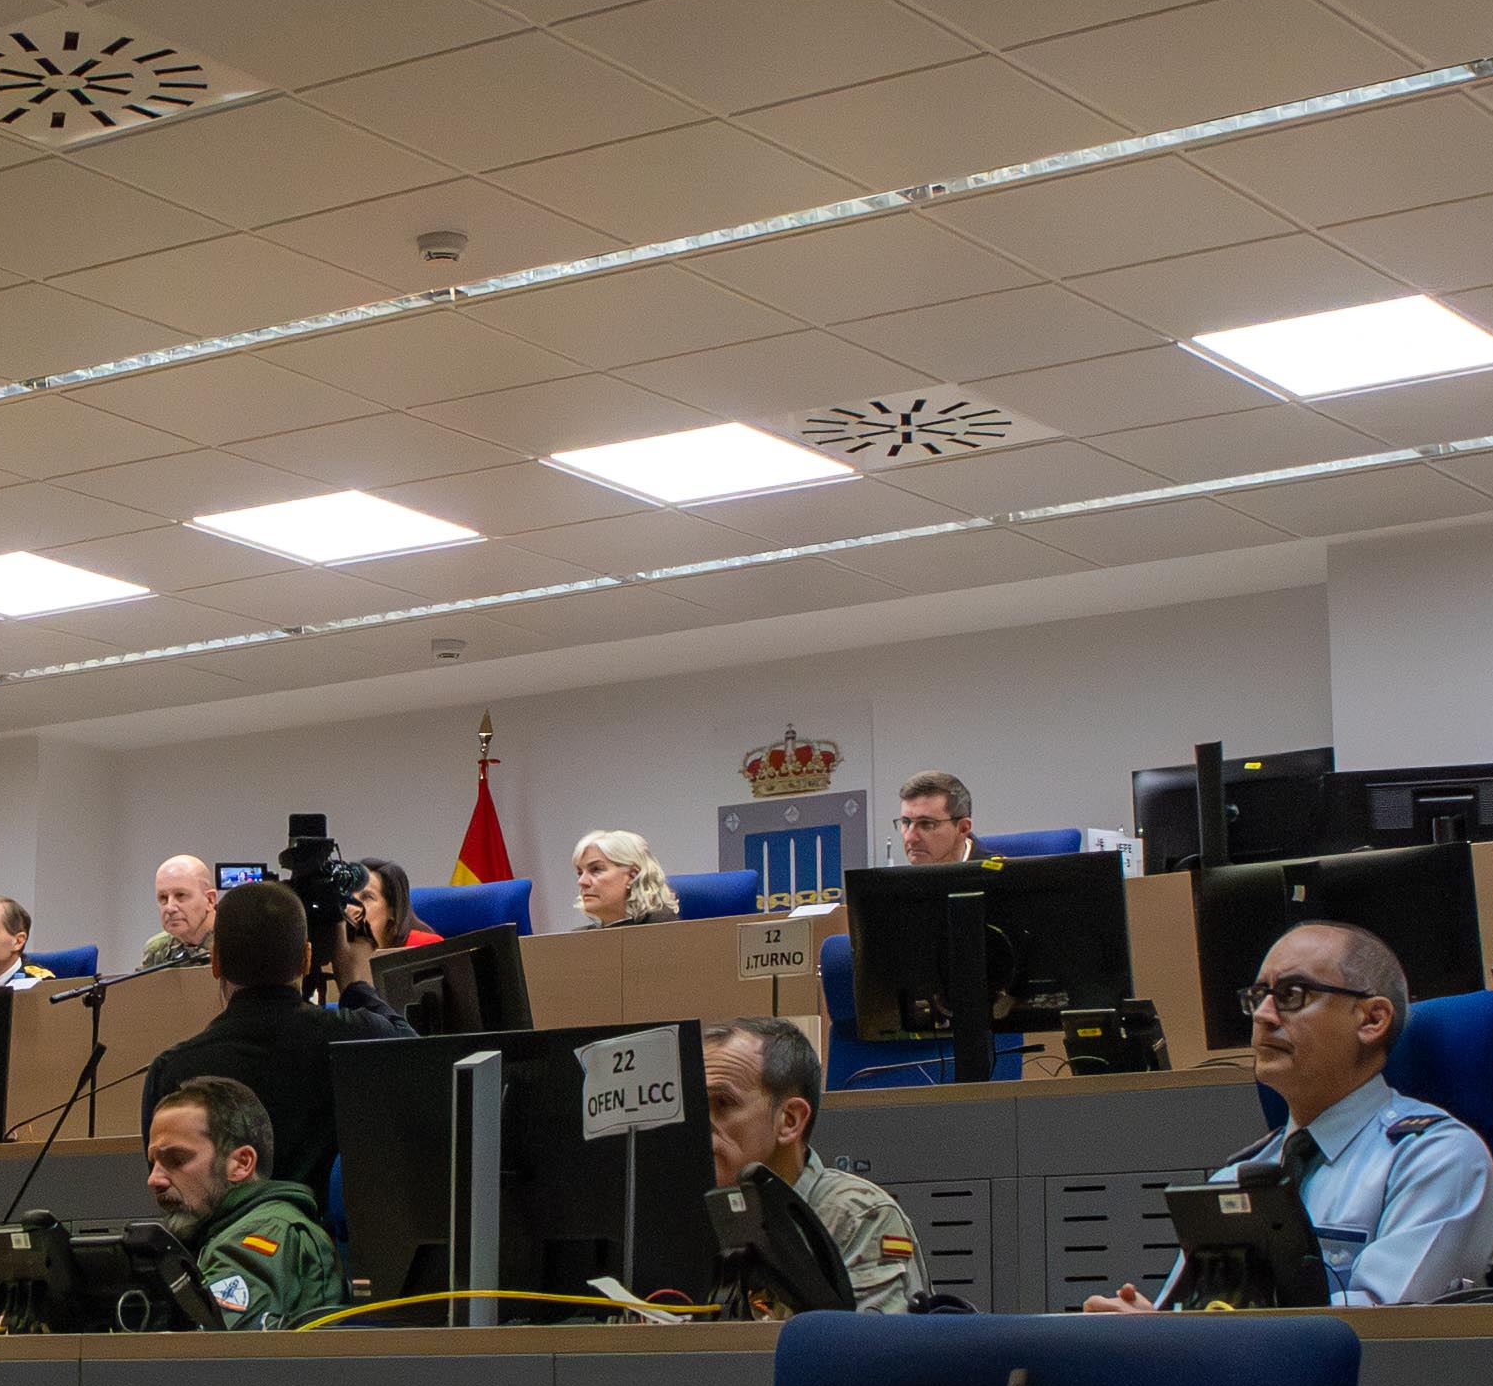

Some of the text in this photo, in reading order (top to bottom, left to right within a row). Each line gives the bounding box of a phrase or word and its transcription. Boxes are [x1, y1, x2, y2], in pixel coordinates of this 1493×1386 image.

[765, 929, 781, 944] 12
[745, 950, 804, 970] J.TURNO
[612, 1049, 635, 1074] 22
[587, 1081, 675, 1118] OFEN_LCC
